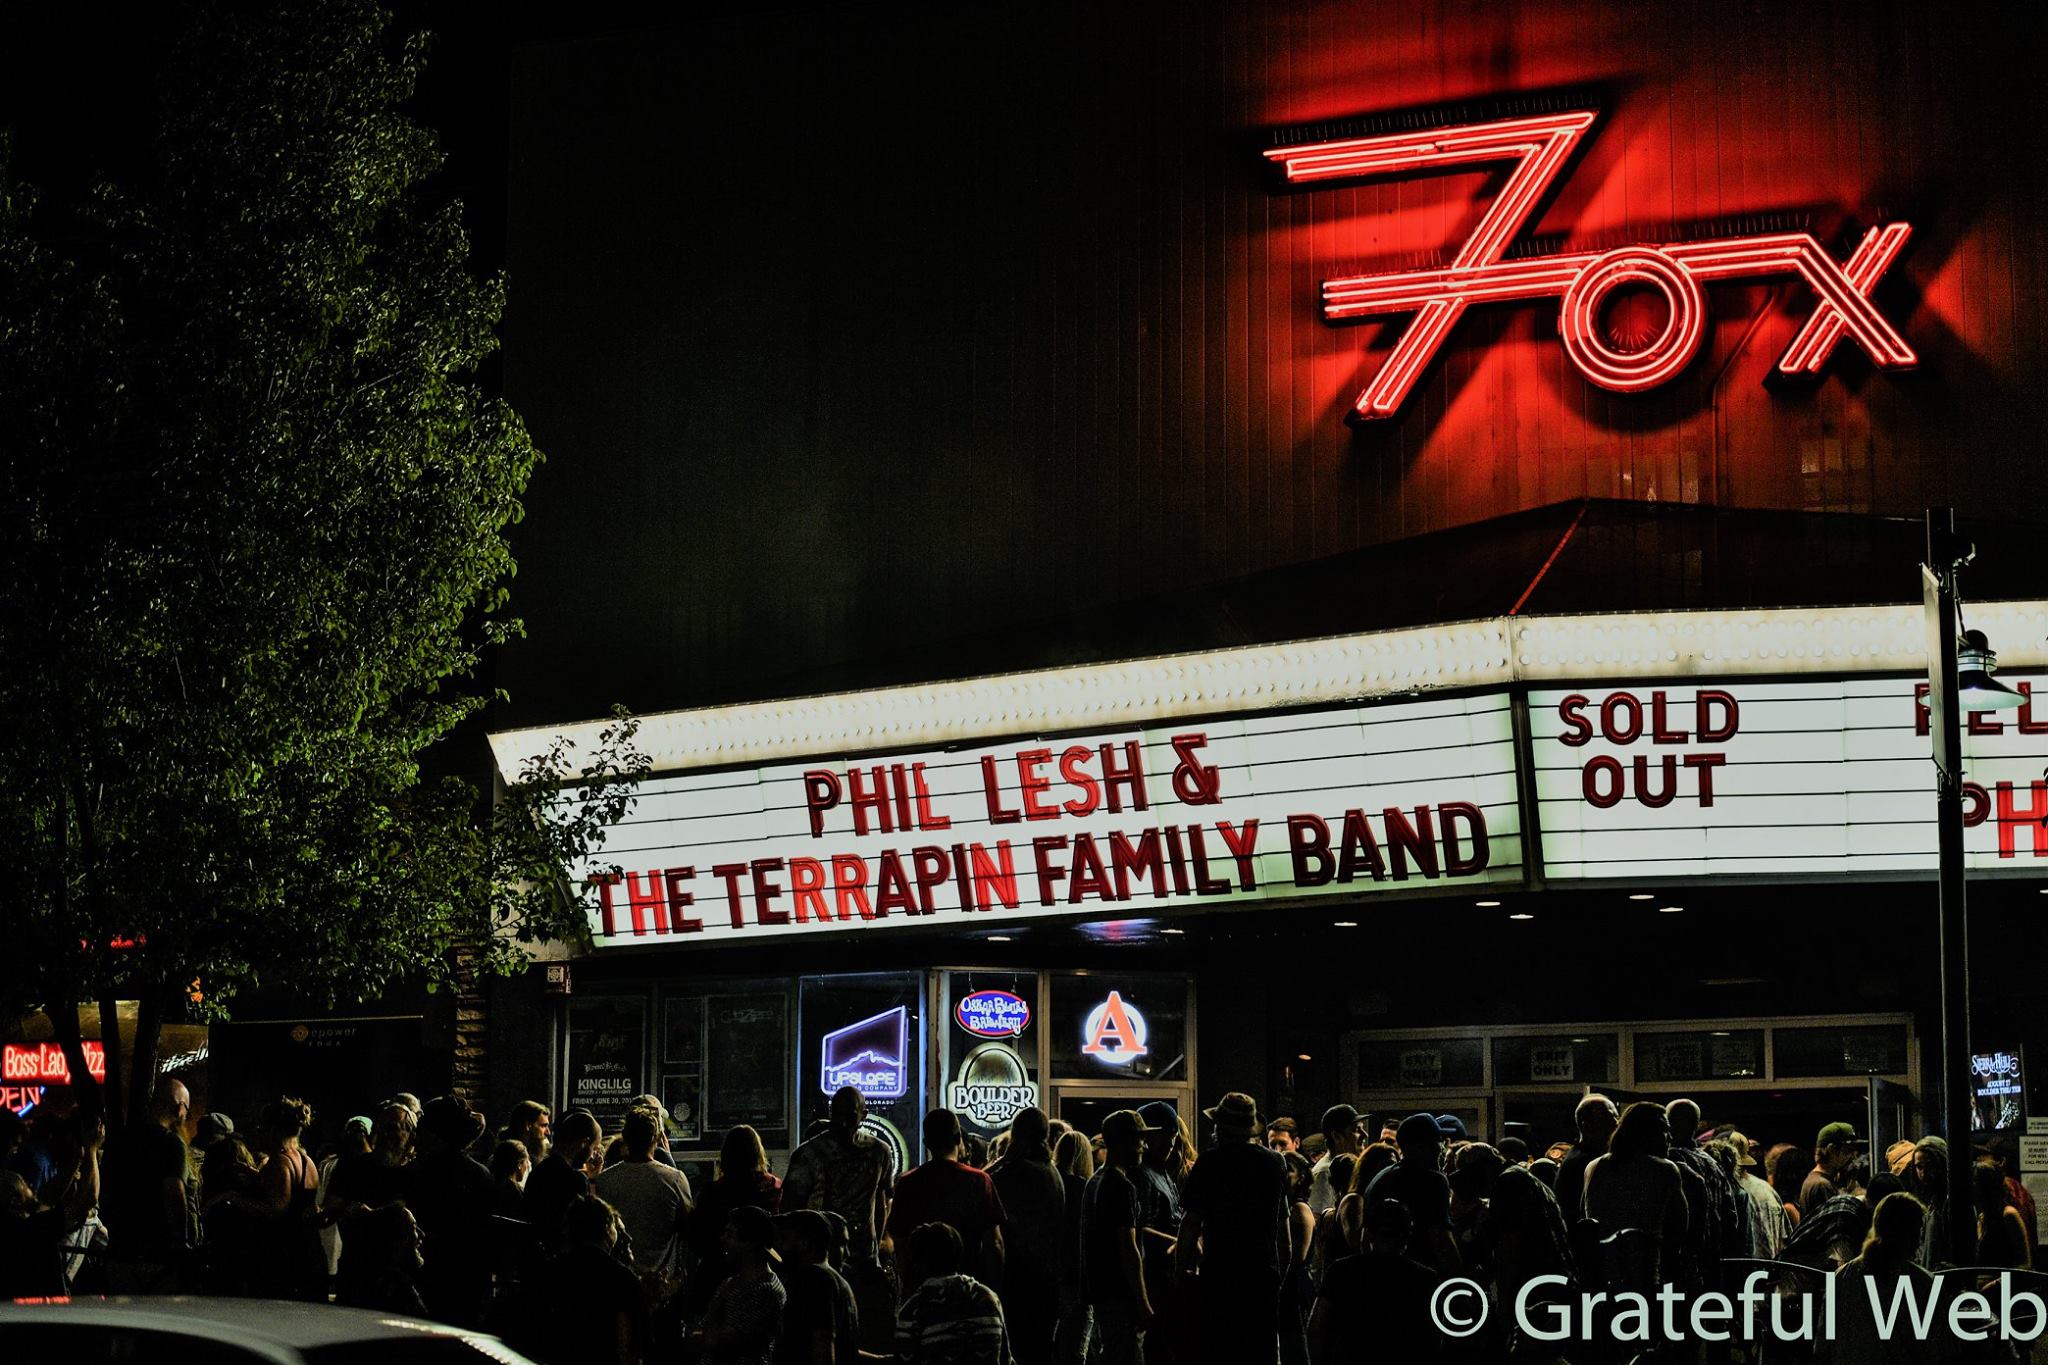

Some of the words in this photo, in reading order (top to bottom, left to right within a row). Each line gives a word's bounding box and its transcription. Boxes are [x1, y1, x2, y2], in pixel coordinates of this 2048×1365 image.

[1558, 689, 1739, 747] SOLD
[804, 761, 951, 838] PHIL
[981, 740, 1150, 825] LESH
[1171, 732, 1223, 805] &
[1582, 753, 1726, 809] OUT
[588, 865, 703, 937] THE
[712, 839, 1019, 930] TERRAPIN
[1033, 818, 1260, 907] FAMILY
[1287, 801, 1491, 888] BAND
[970, 1013, 1021, 1034] BREWERY
[1082, 990, 1148, 1054] A
[5, 1045, 40, 1077] Boss
[1405, 1055, 1436, 1066] EXIT
[1535, 1052, 1567, 1062] EXIT
[829, 1072, 898, 1086] UPSLOPE
[1403, 1069, 1440, 1080] ONLY
[1533, 1065, 1570, 1076] ONLY
[955, 1086, 1034, 1108] BOULDER
[976, 1102, 1012, 1119] BEER
